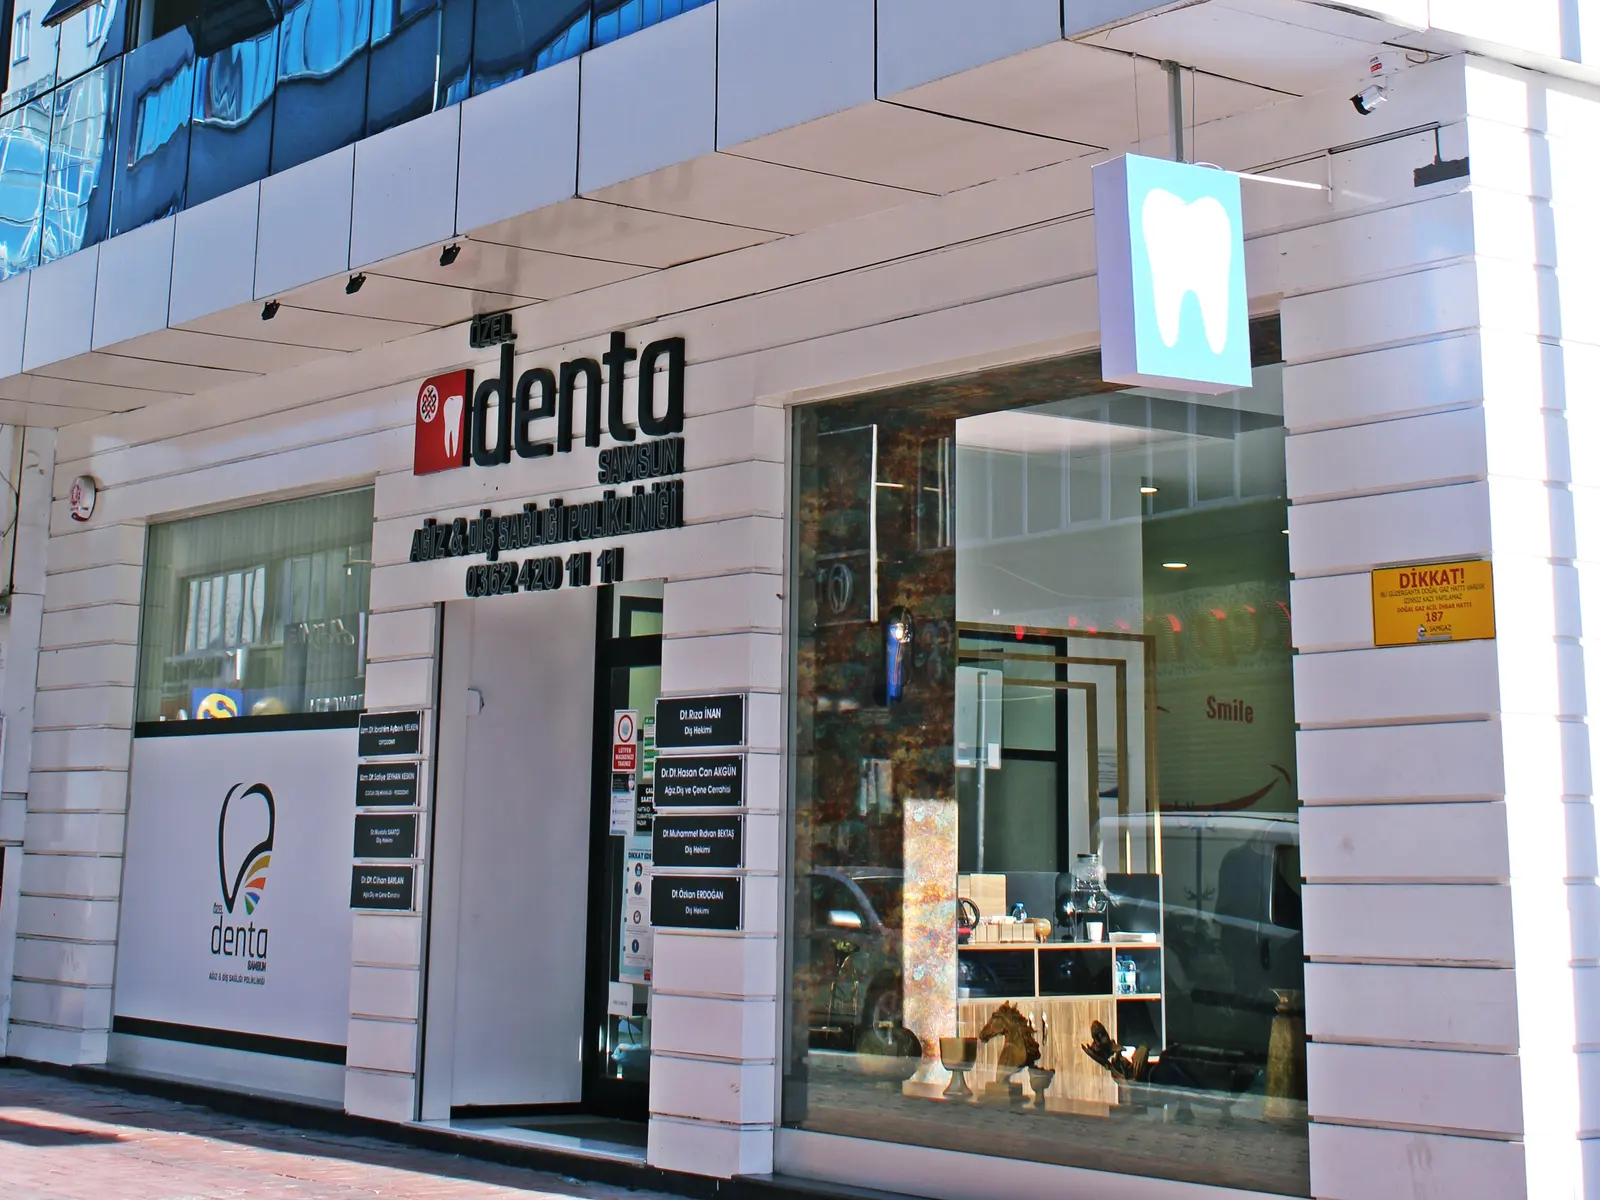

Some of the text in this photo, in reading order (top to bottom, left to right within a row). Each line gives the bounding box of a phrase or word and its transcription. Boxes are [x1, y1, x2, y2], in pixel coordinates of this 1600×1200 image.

[469, 313, 517, 348] ÖZEL
[472, 331, 685, 467] denta
[598, 437, 684, 484] SAMSUN
[409, 479, 684, 562] AĞIZ & DİŞ SAĞLIĞI POLİKLİNİĞİ
[465, 547, 624, 597] 0362 420 11 11
[1400, 568, 1464, 589] DİKKAT!
[1426, 611, 1443, 622] 187
[704, 705, 721, 719] İNAN
[1206, 695, 1254, 724] Smile
[684, 726, 712, 736] Diş Hekimi
[699, 767, 712, 777] Can
[714, 764, 737, 777] AKGÜN
[692, 786, 706, 796] Çene
[717, 829, 734, 840] BEKTAŞ
[693, 846, 710, 854] Hekimi
[697, 889, 724, 900] ERDOĞAN
[693, 906, 710, 914] Hekimi
[211, 915, 268, 959] denta
